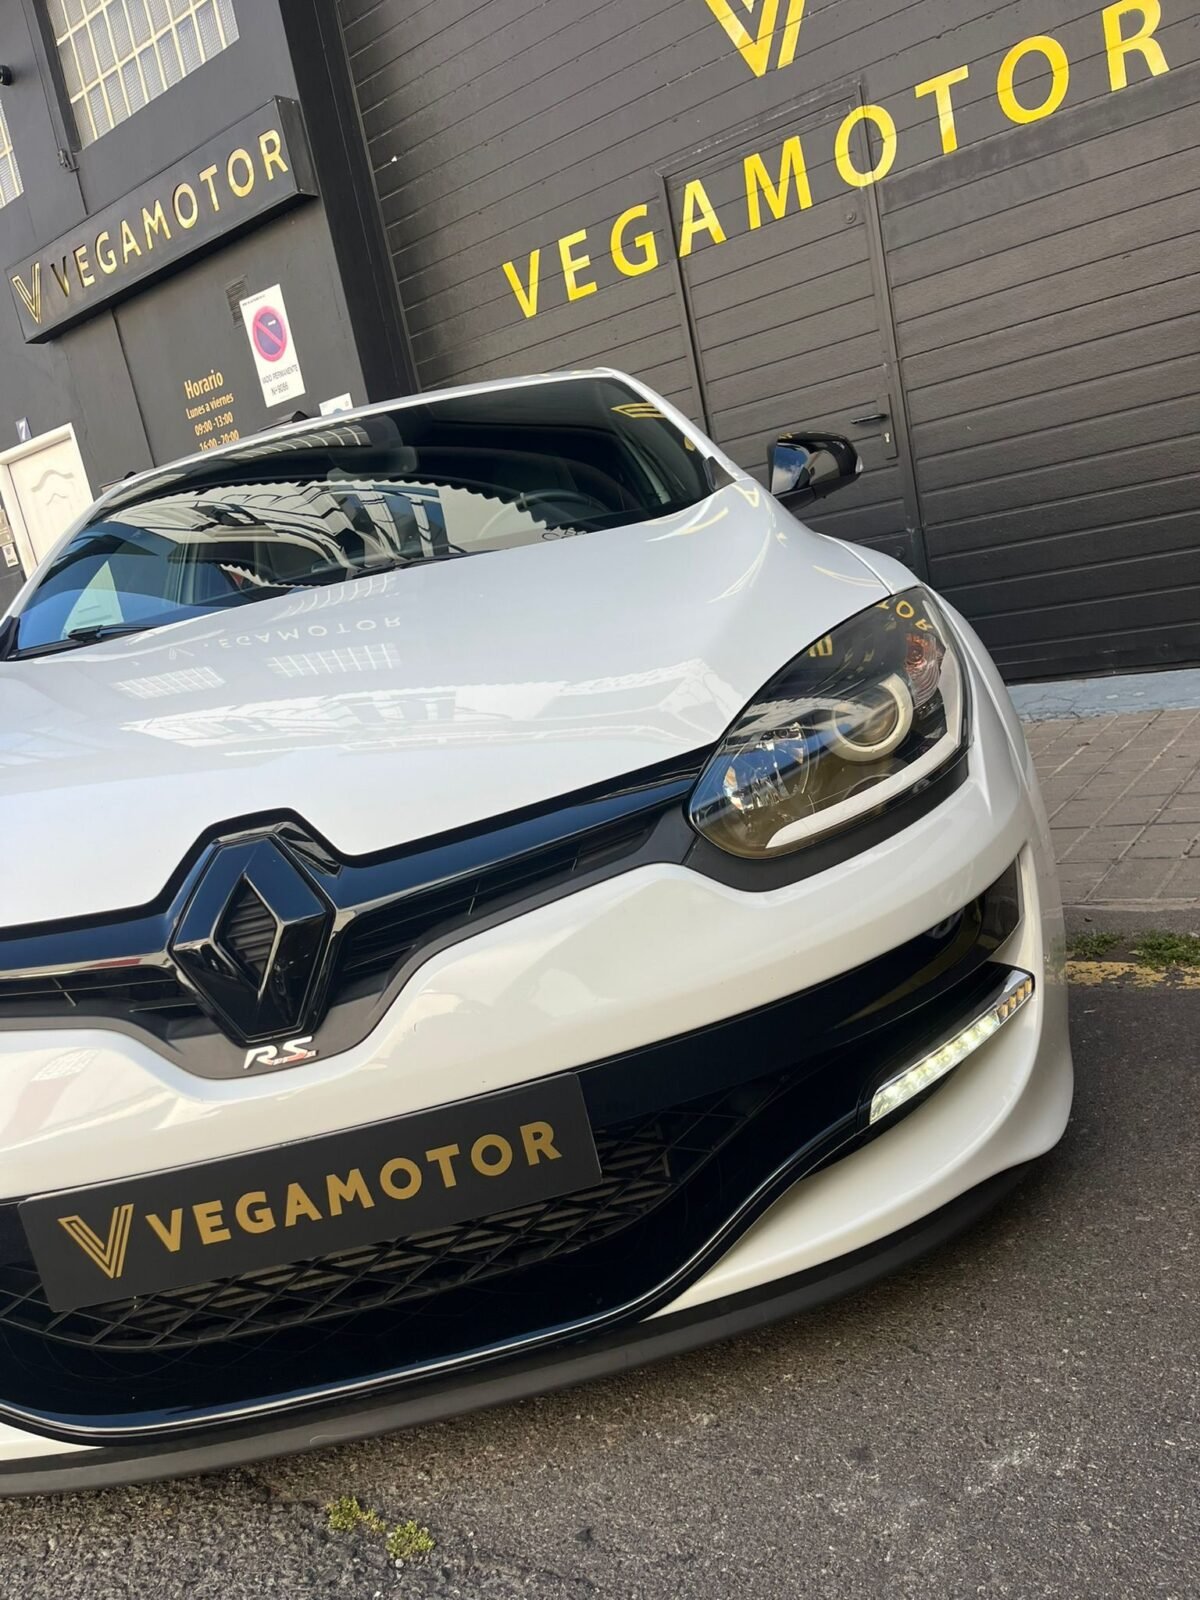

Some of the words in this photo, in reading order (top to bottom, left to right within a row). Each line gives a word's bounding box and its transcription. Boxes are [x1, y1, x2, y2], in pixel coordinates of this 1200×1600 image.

[50, 129, 289, 298] VEGAMOTOR
[502, 0, 1170, 319] VEGAMOTOR
[184, 369, 224, 400] Horario
[185, 404, 206, 420] Lunes
[209, 392, 234, 411] viernes
[145, 1121, 562, 1252] VEGAMOTOR
